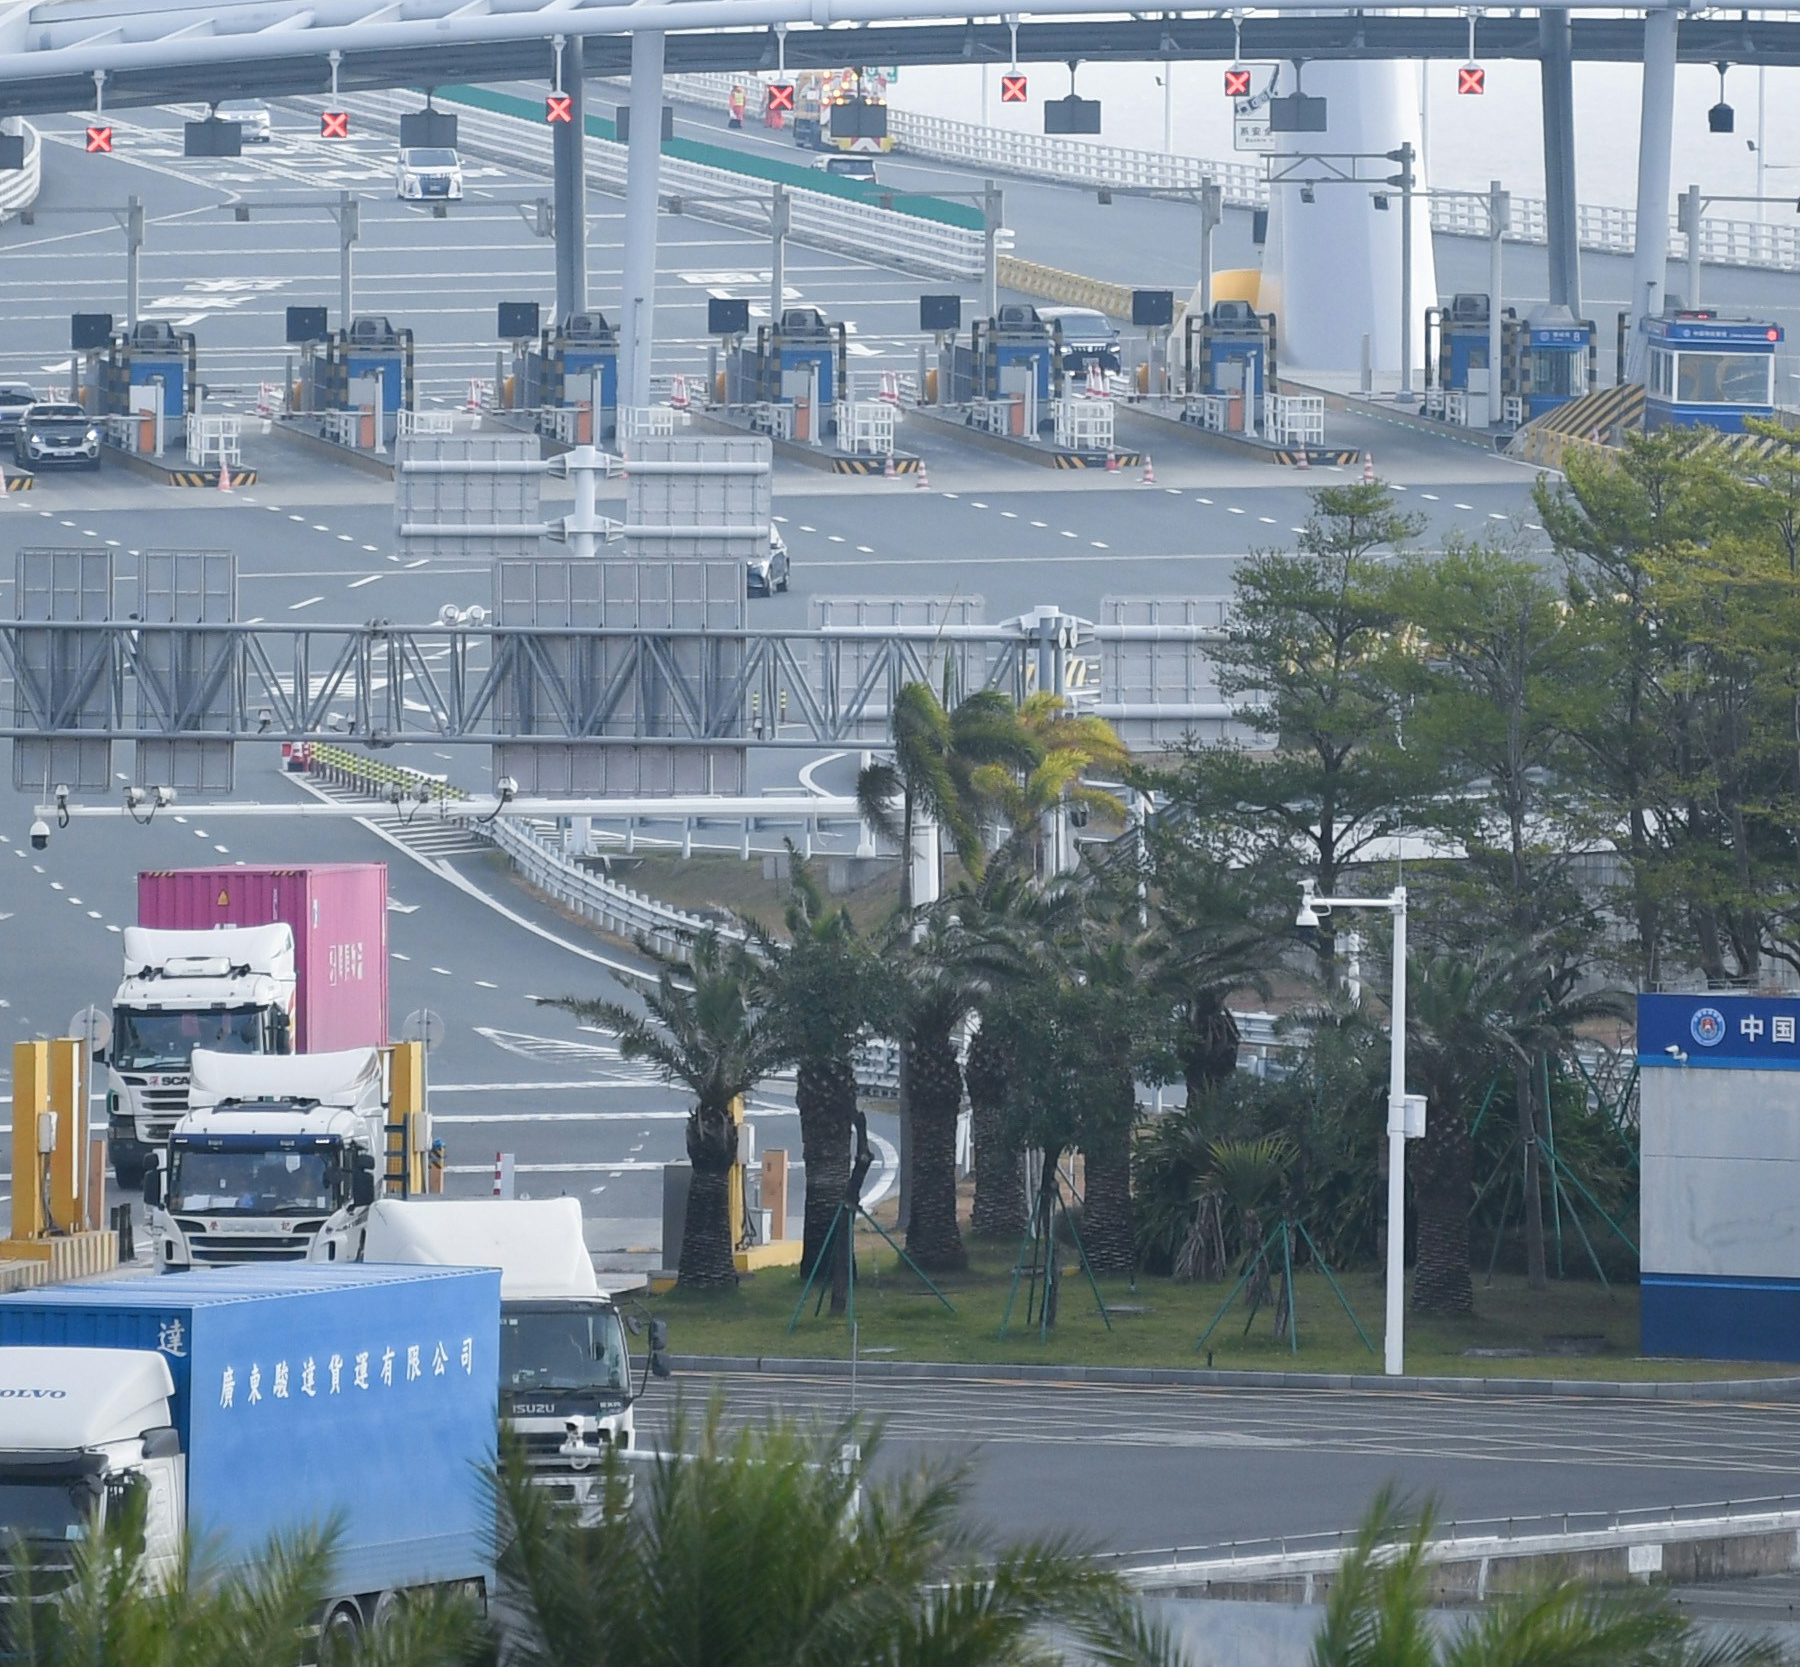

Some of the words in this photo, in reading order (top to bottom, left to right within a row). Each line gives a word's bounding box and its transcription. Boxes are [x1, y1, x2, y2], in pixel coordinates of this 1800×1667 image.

[161, 1076, 190, 1086] SCA
[219, 1337, 474, 1410] 廣東駿達貨運有限公司
[512, 1403, 555, 1414] ISUZU
